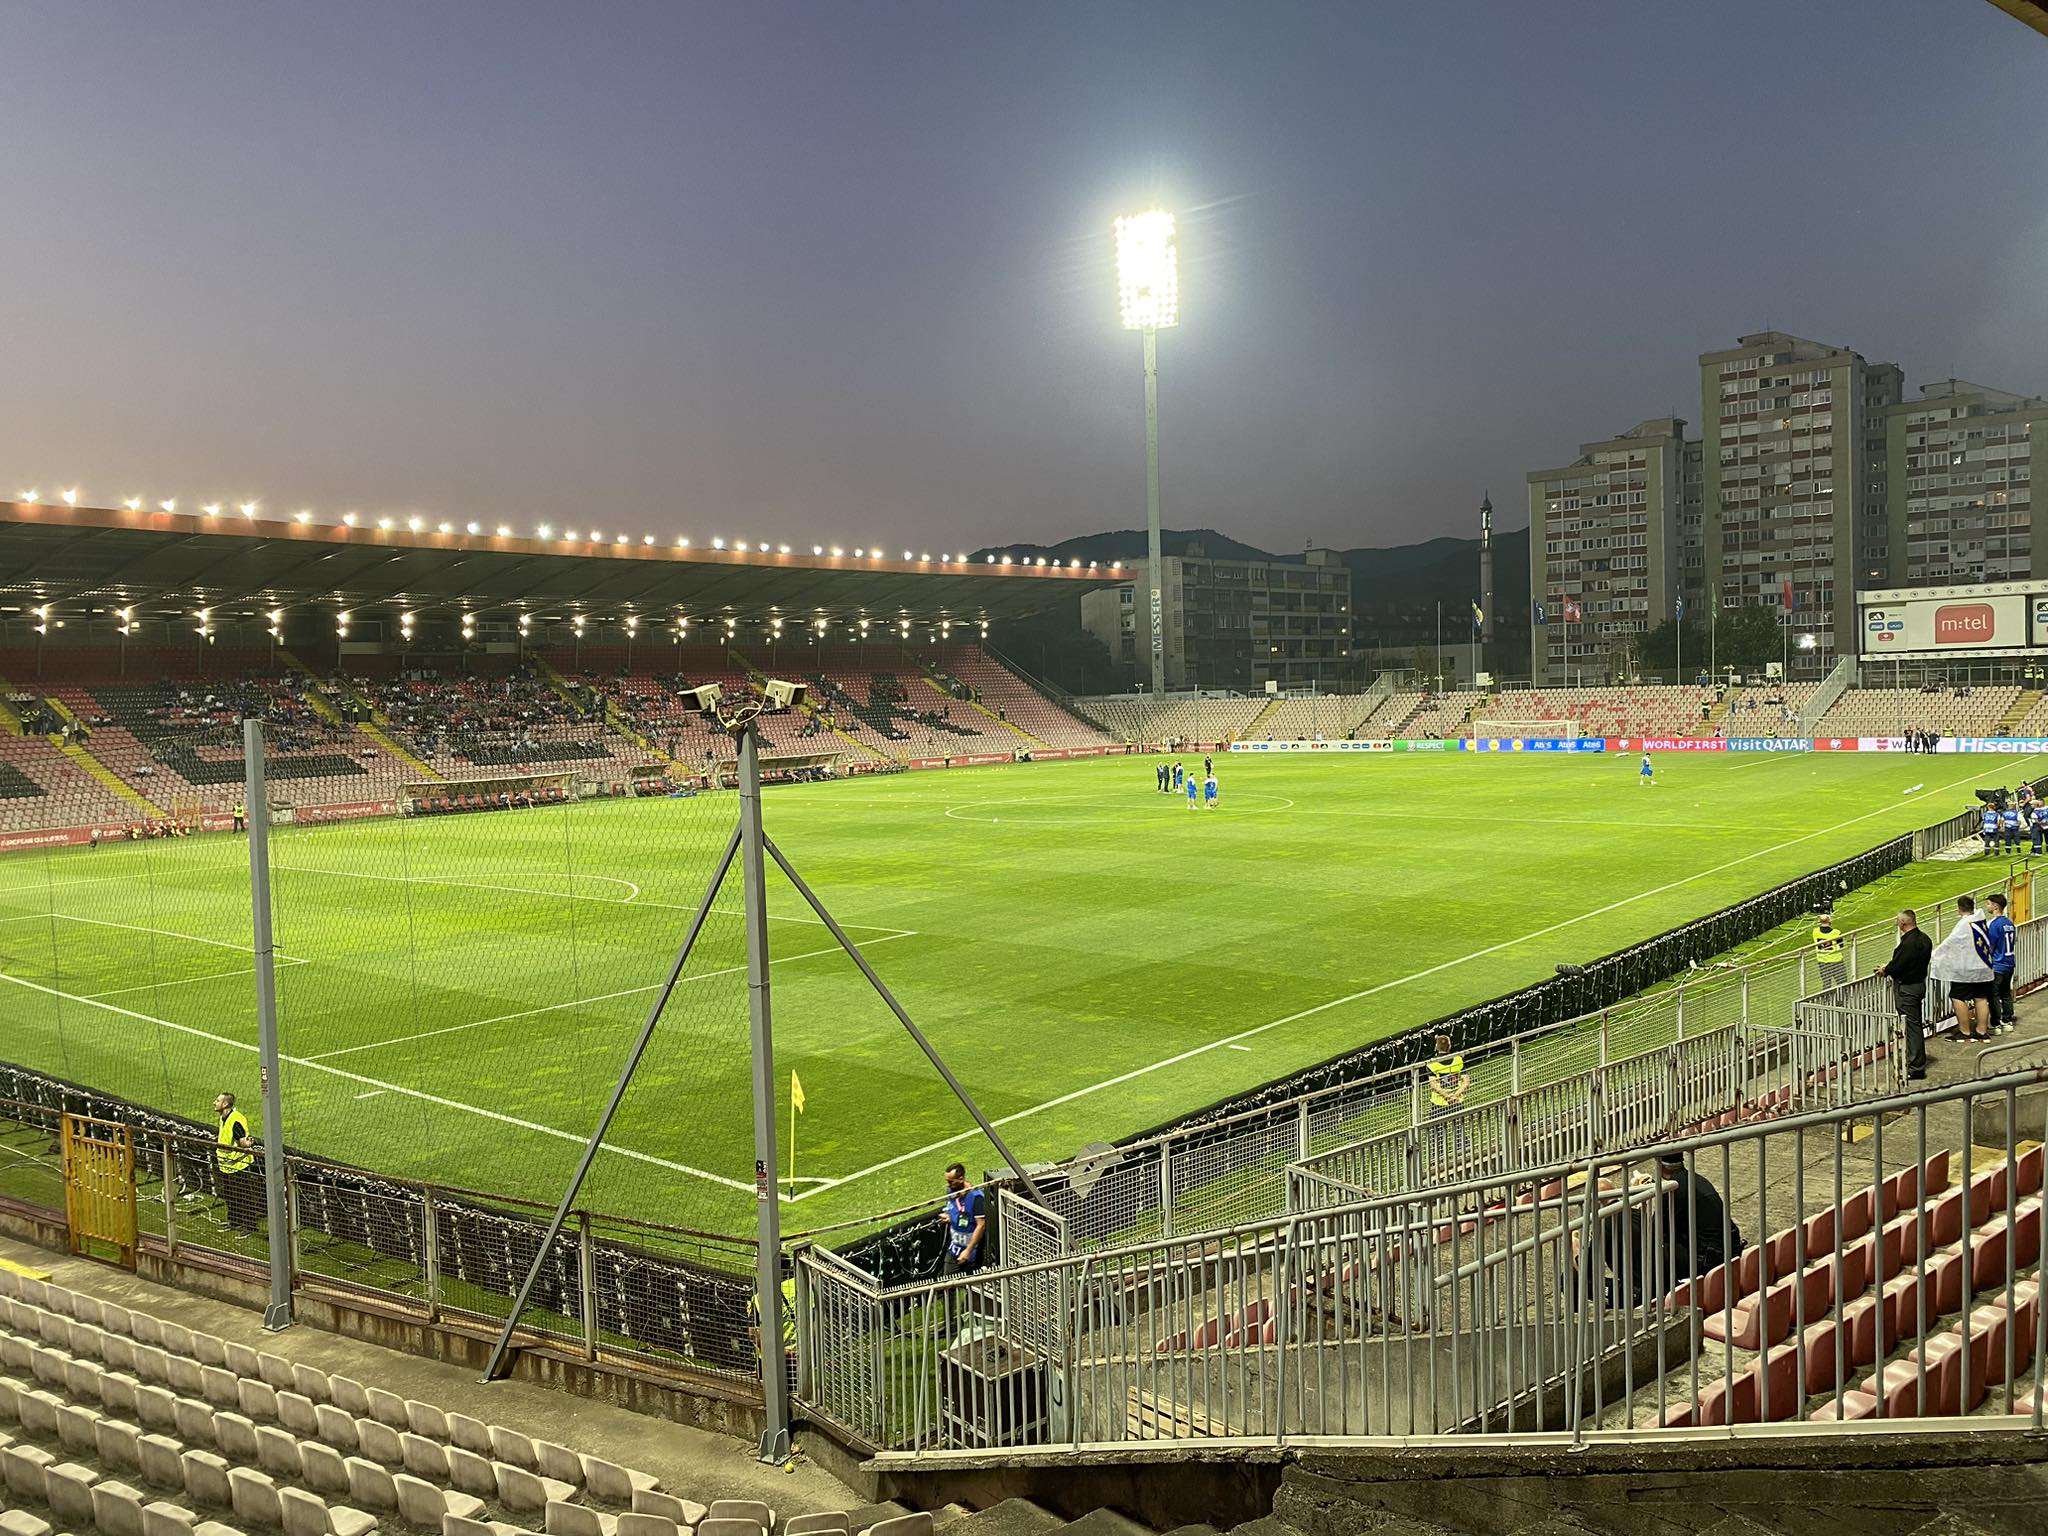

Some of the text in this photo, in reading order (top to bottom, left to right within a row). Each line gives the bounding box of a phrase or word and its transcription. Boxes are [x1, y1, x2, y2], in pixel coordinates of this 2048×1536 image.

[1152, 597, 1162, 650] MESSER
[1942, 614, 1987, 631] m:tel
[1960, 738, 2048, 752] Hisense
